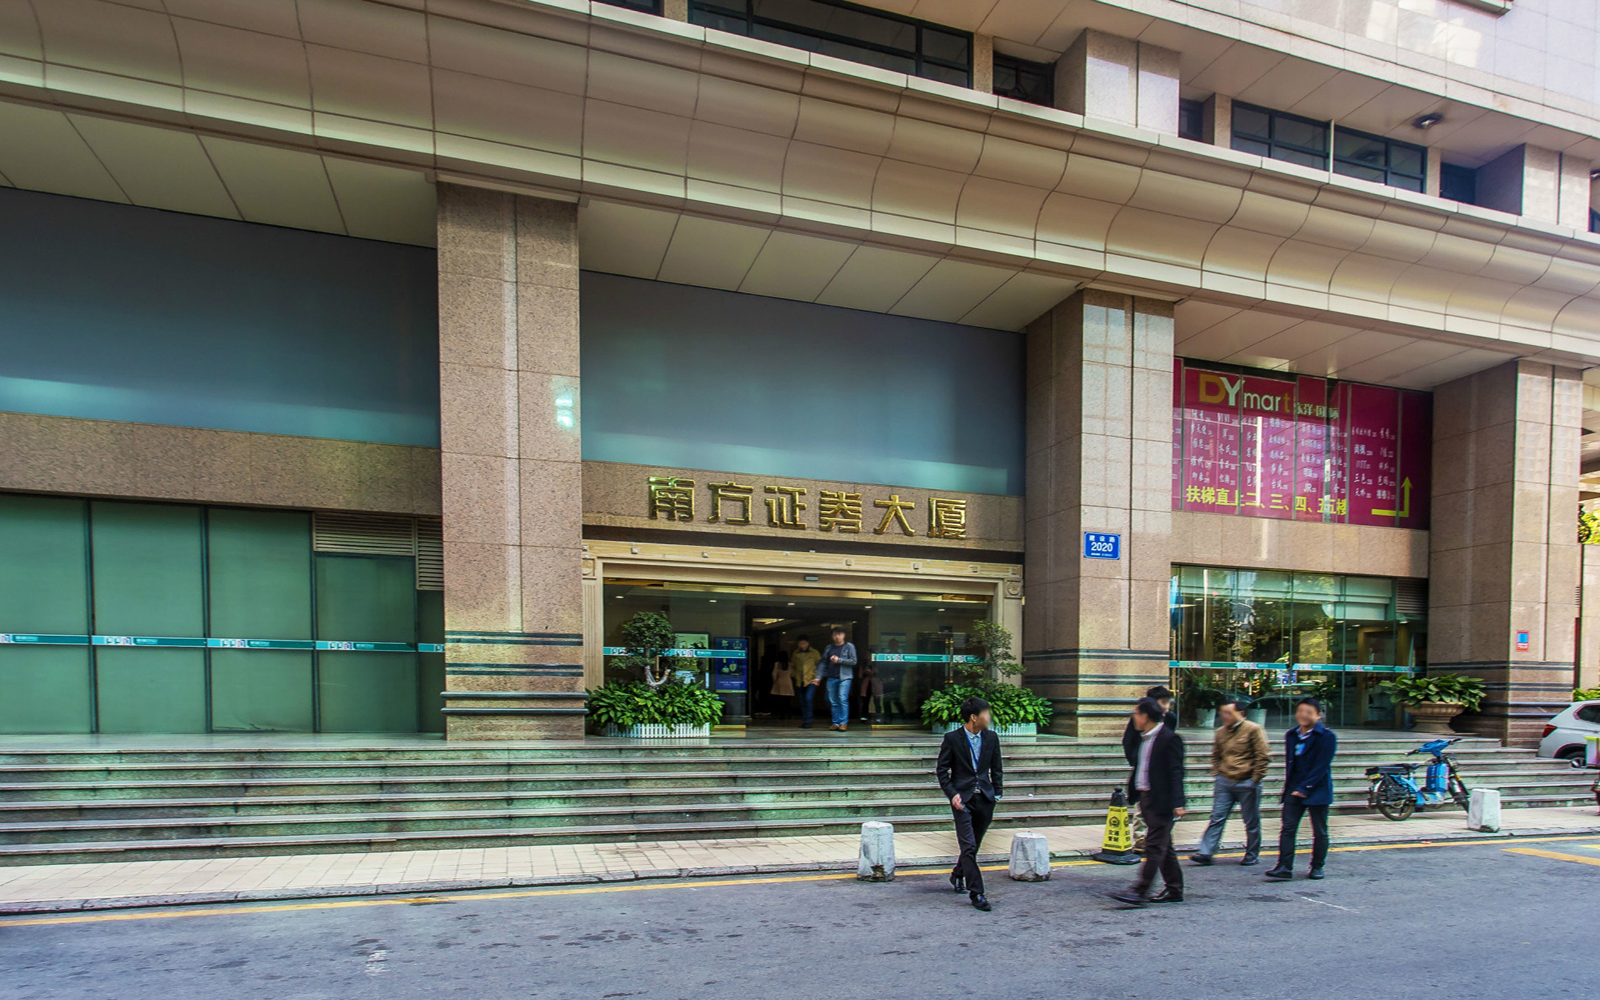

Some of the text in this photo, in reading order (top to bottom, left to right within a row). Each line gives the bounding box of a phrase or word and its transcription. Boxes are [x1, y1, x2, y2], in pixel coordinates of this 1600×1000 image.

[647, 475, 968, 539] 南方证券大厦
[1091, 541, 1113, 552] 2020
